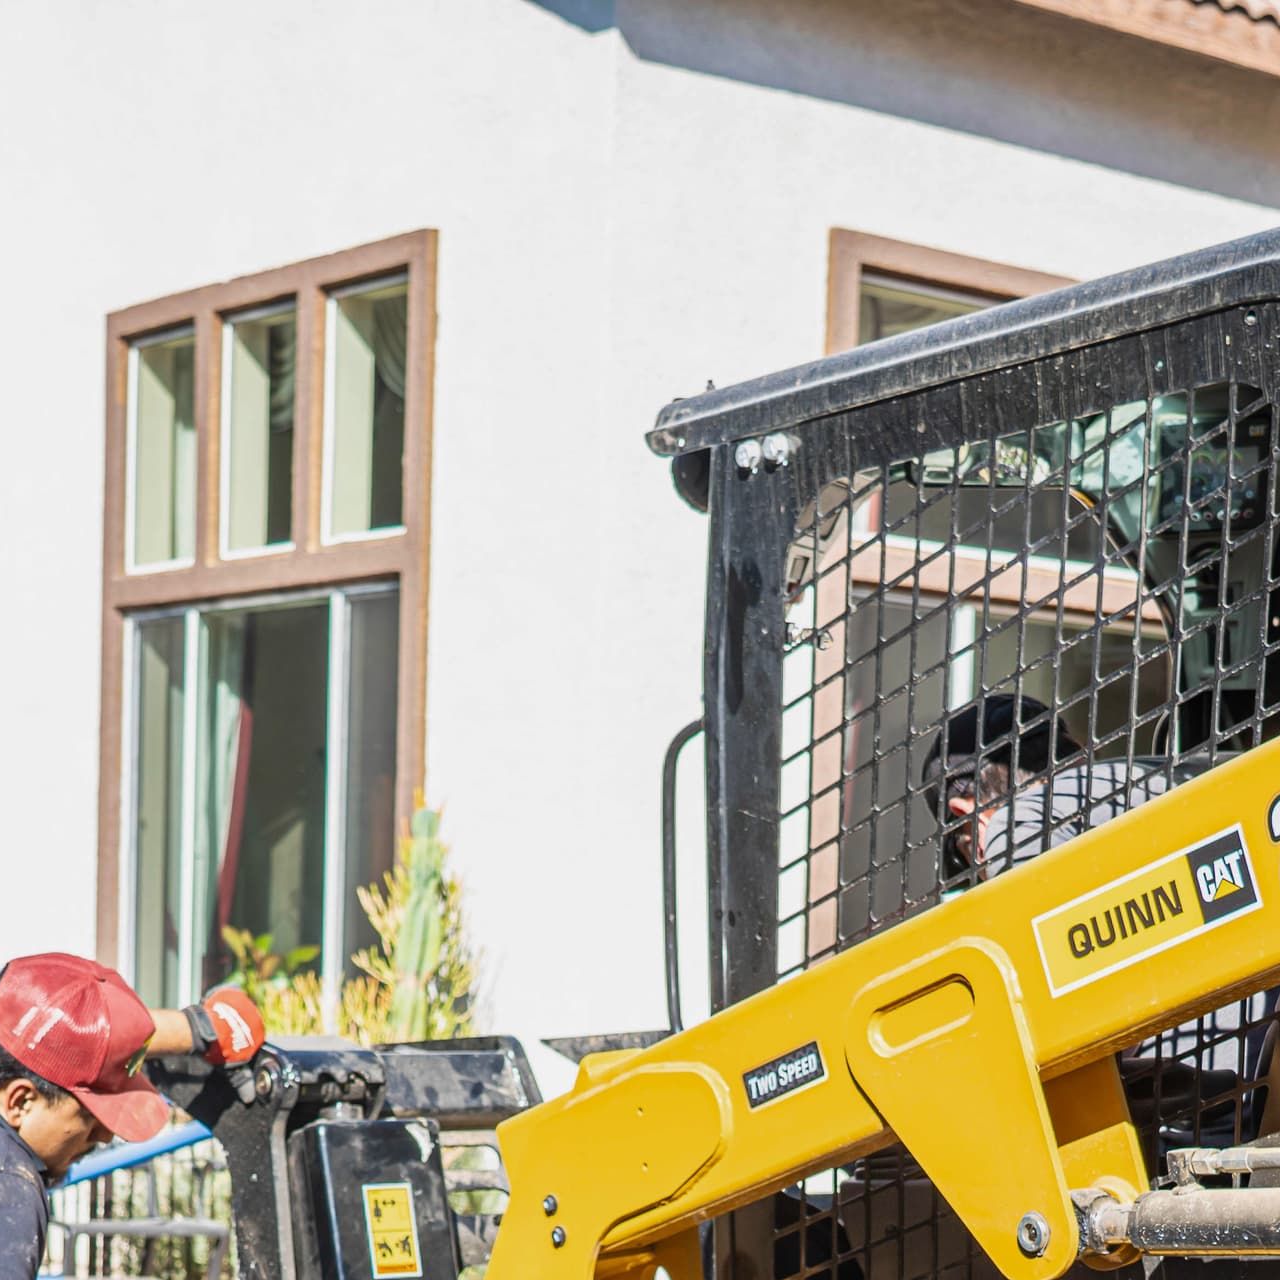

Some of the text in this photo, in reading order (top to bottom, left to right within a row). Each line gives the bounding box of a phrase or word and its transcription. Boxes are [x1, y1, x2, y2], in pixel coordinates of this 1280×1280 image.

[1068, 850, 1244, 959] QUINN CAT
[748, 1053, 818, 1099] TWO SPEED
